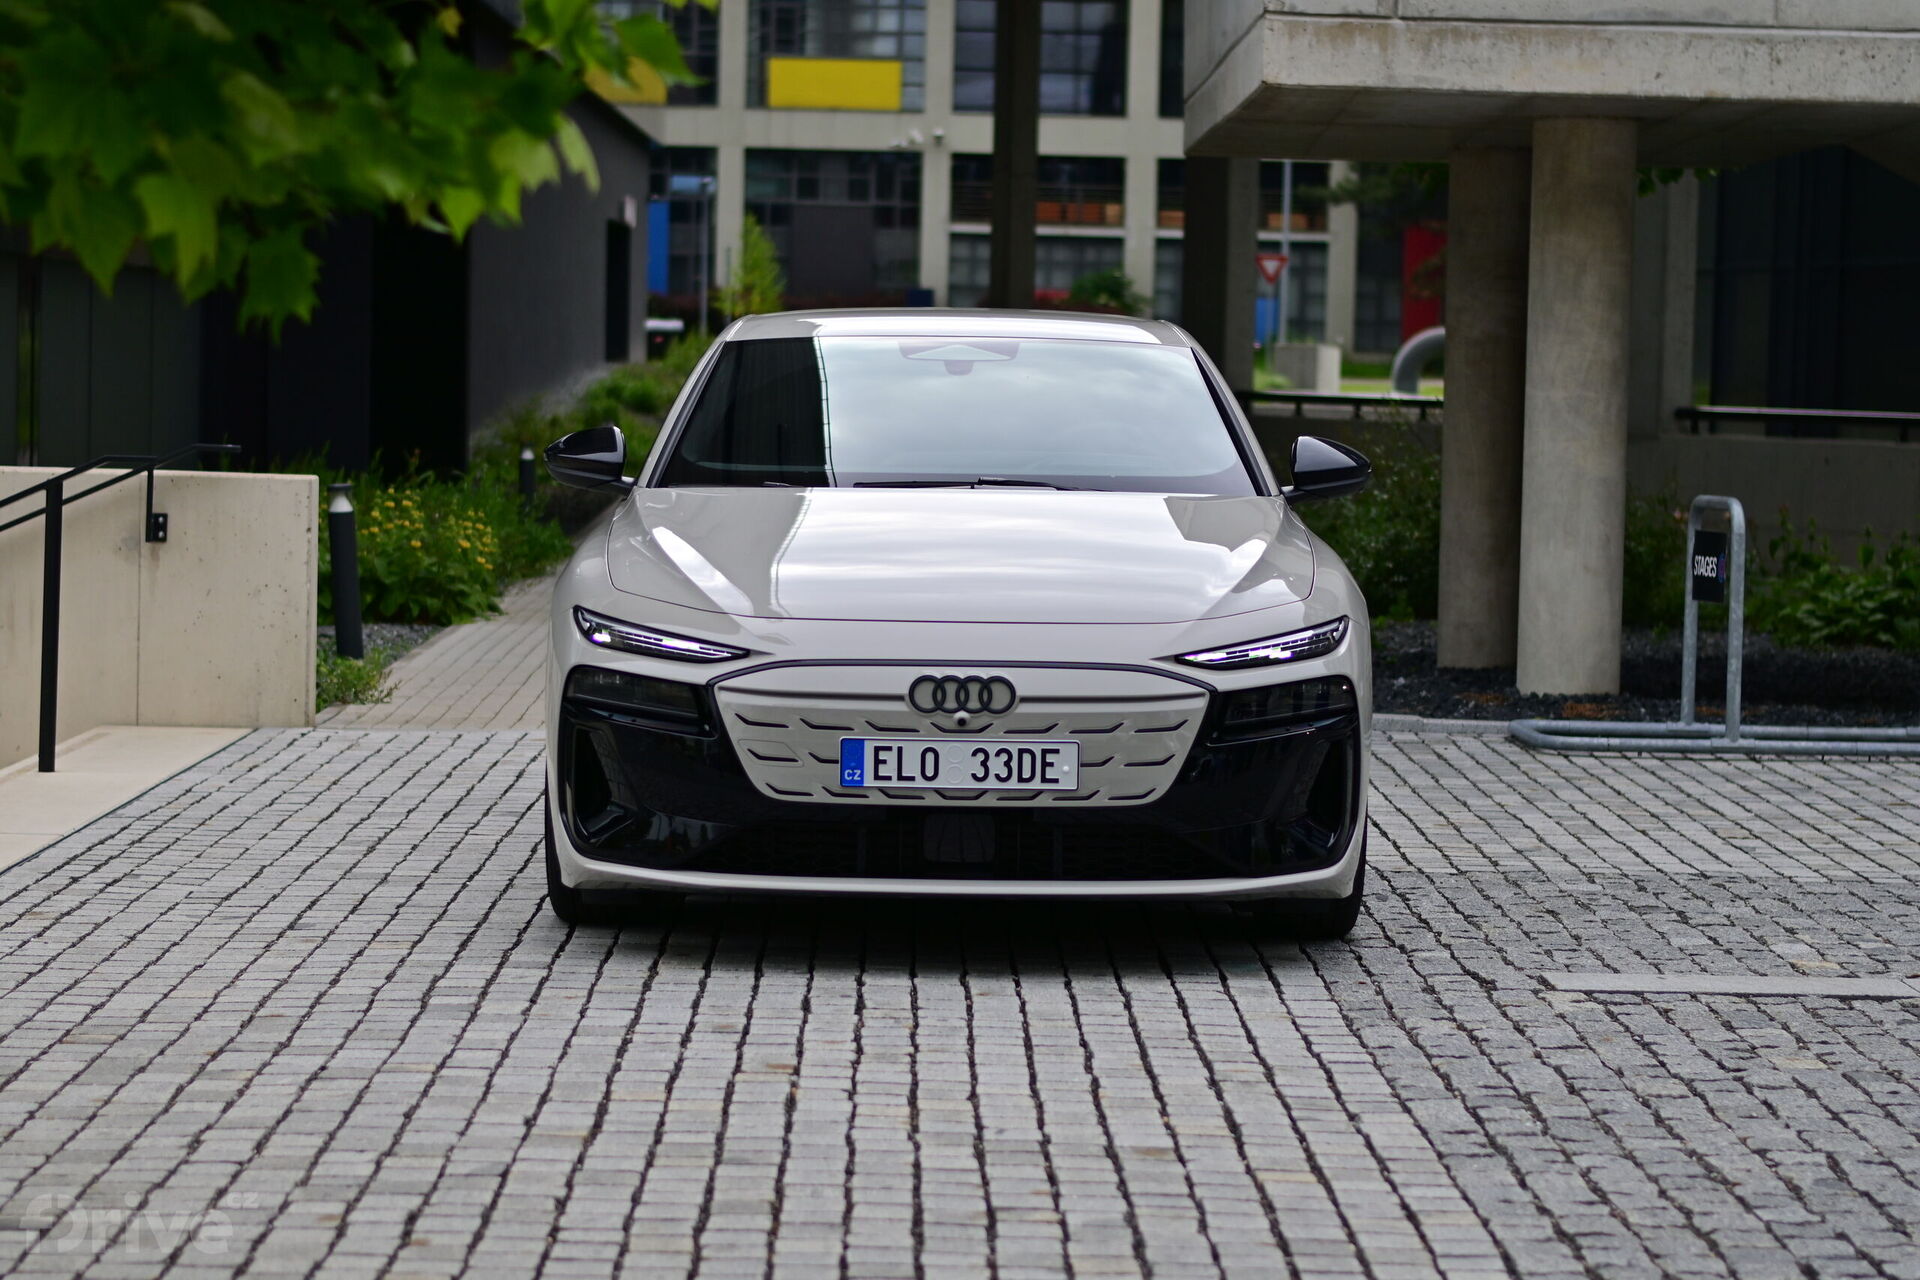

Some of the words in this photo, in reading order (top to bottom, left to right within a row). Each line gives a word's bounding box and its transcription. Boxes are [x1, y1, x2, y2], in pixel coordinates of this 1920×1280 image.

[1694, 555, 1718, 578] STAGES
[844, 769, 862, 781] CZ
[970, 747, 1061, 784] 33DE
